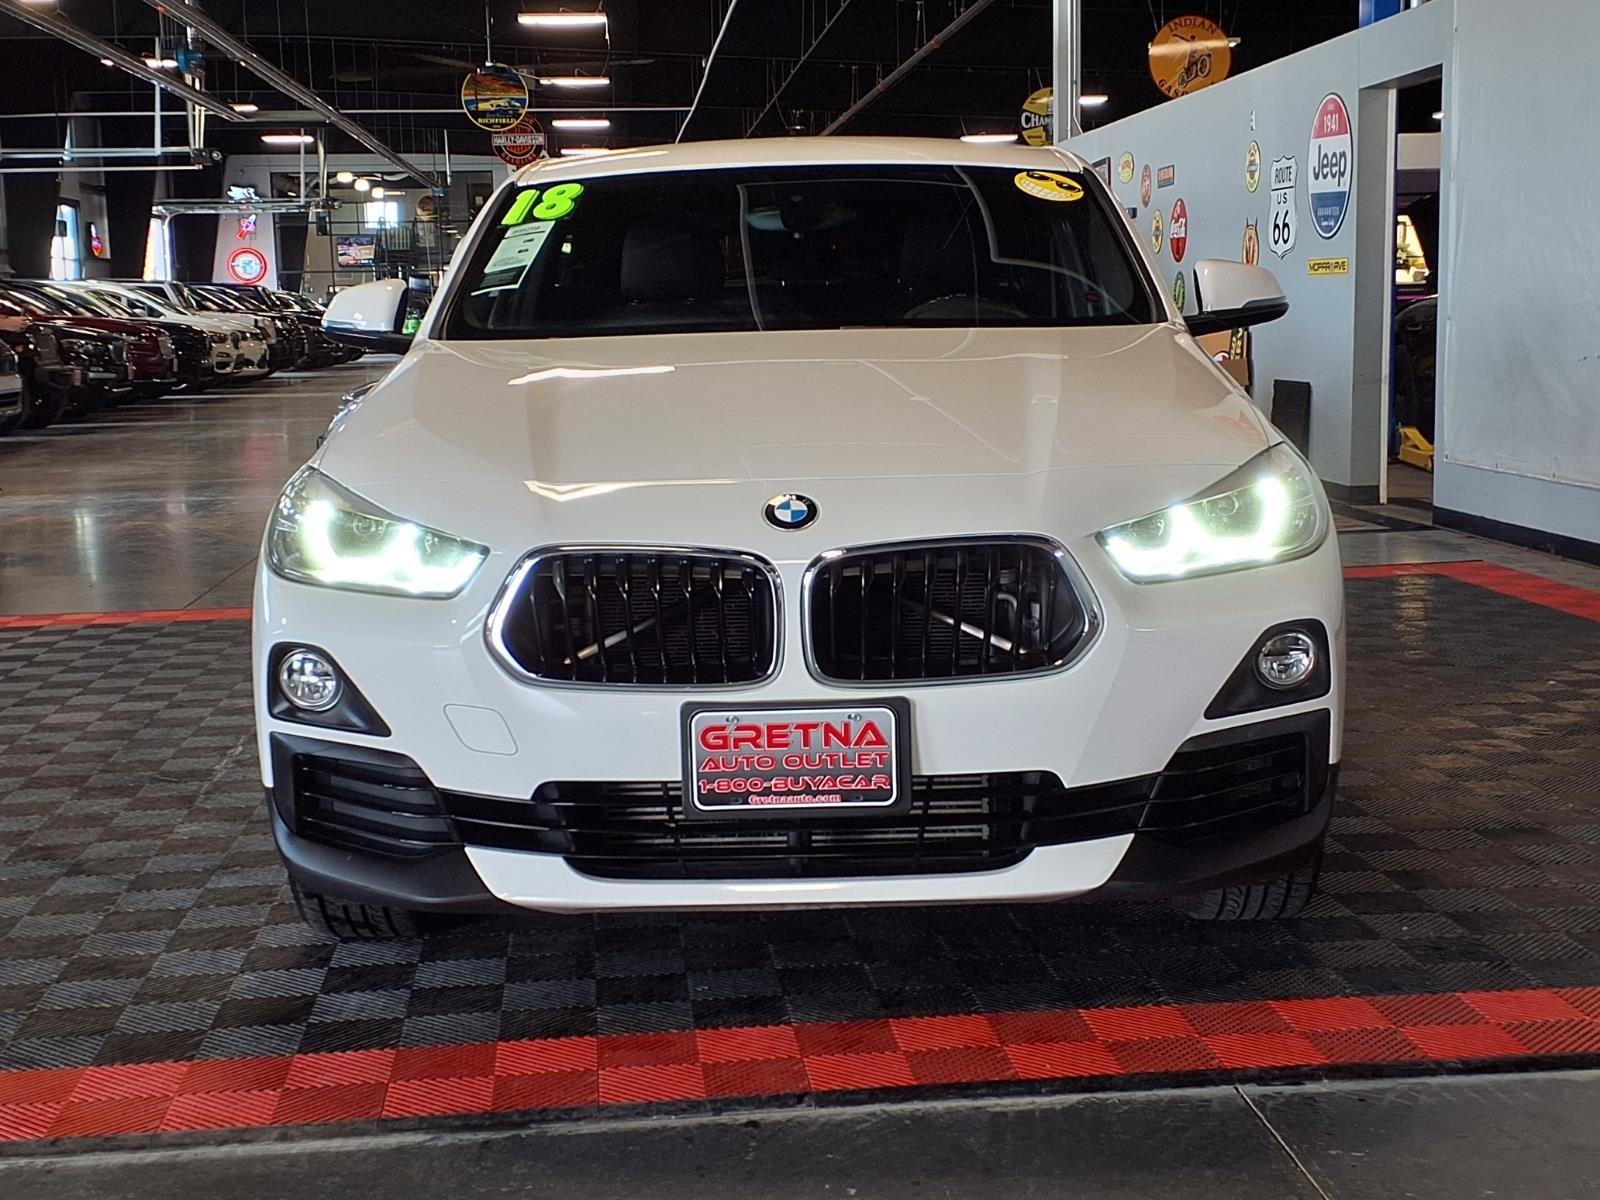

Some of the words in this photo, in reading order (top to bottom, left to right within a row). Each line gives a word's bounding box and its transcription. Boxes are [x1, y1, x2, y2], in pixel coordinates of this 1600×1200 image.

[1167, 17, 1218, 34] INDIAN
[1323, 112, 1339, 134] 1941
[1274, 166, 1293, 184] ROUTE
[1312, 144, 1347, 187] Jeep
[501, 183, 584, 226] 18
[1276, 192, 1288, 205] US
[1272, 209, 1290, 246] 66
[699, 721, 889, 752] GRETNA
[698, 754, 776, 773] AUTO
[782, 751, 890, 771] OUTLET
[698, 774, 891, 795] 1-800-BUYACAR
